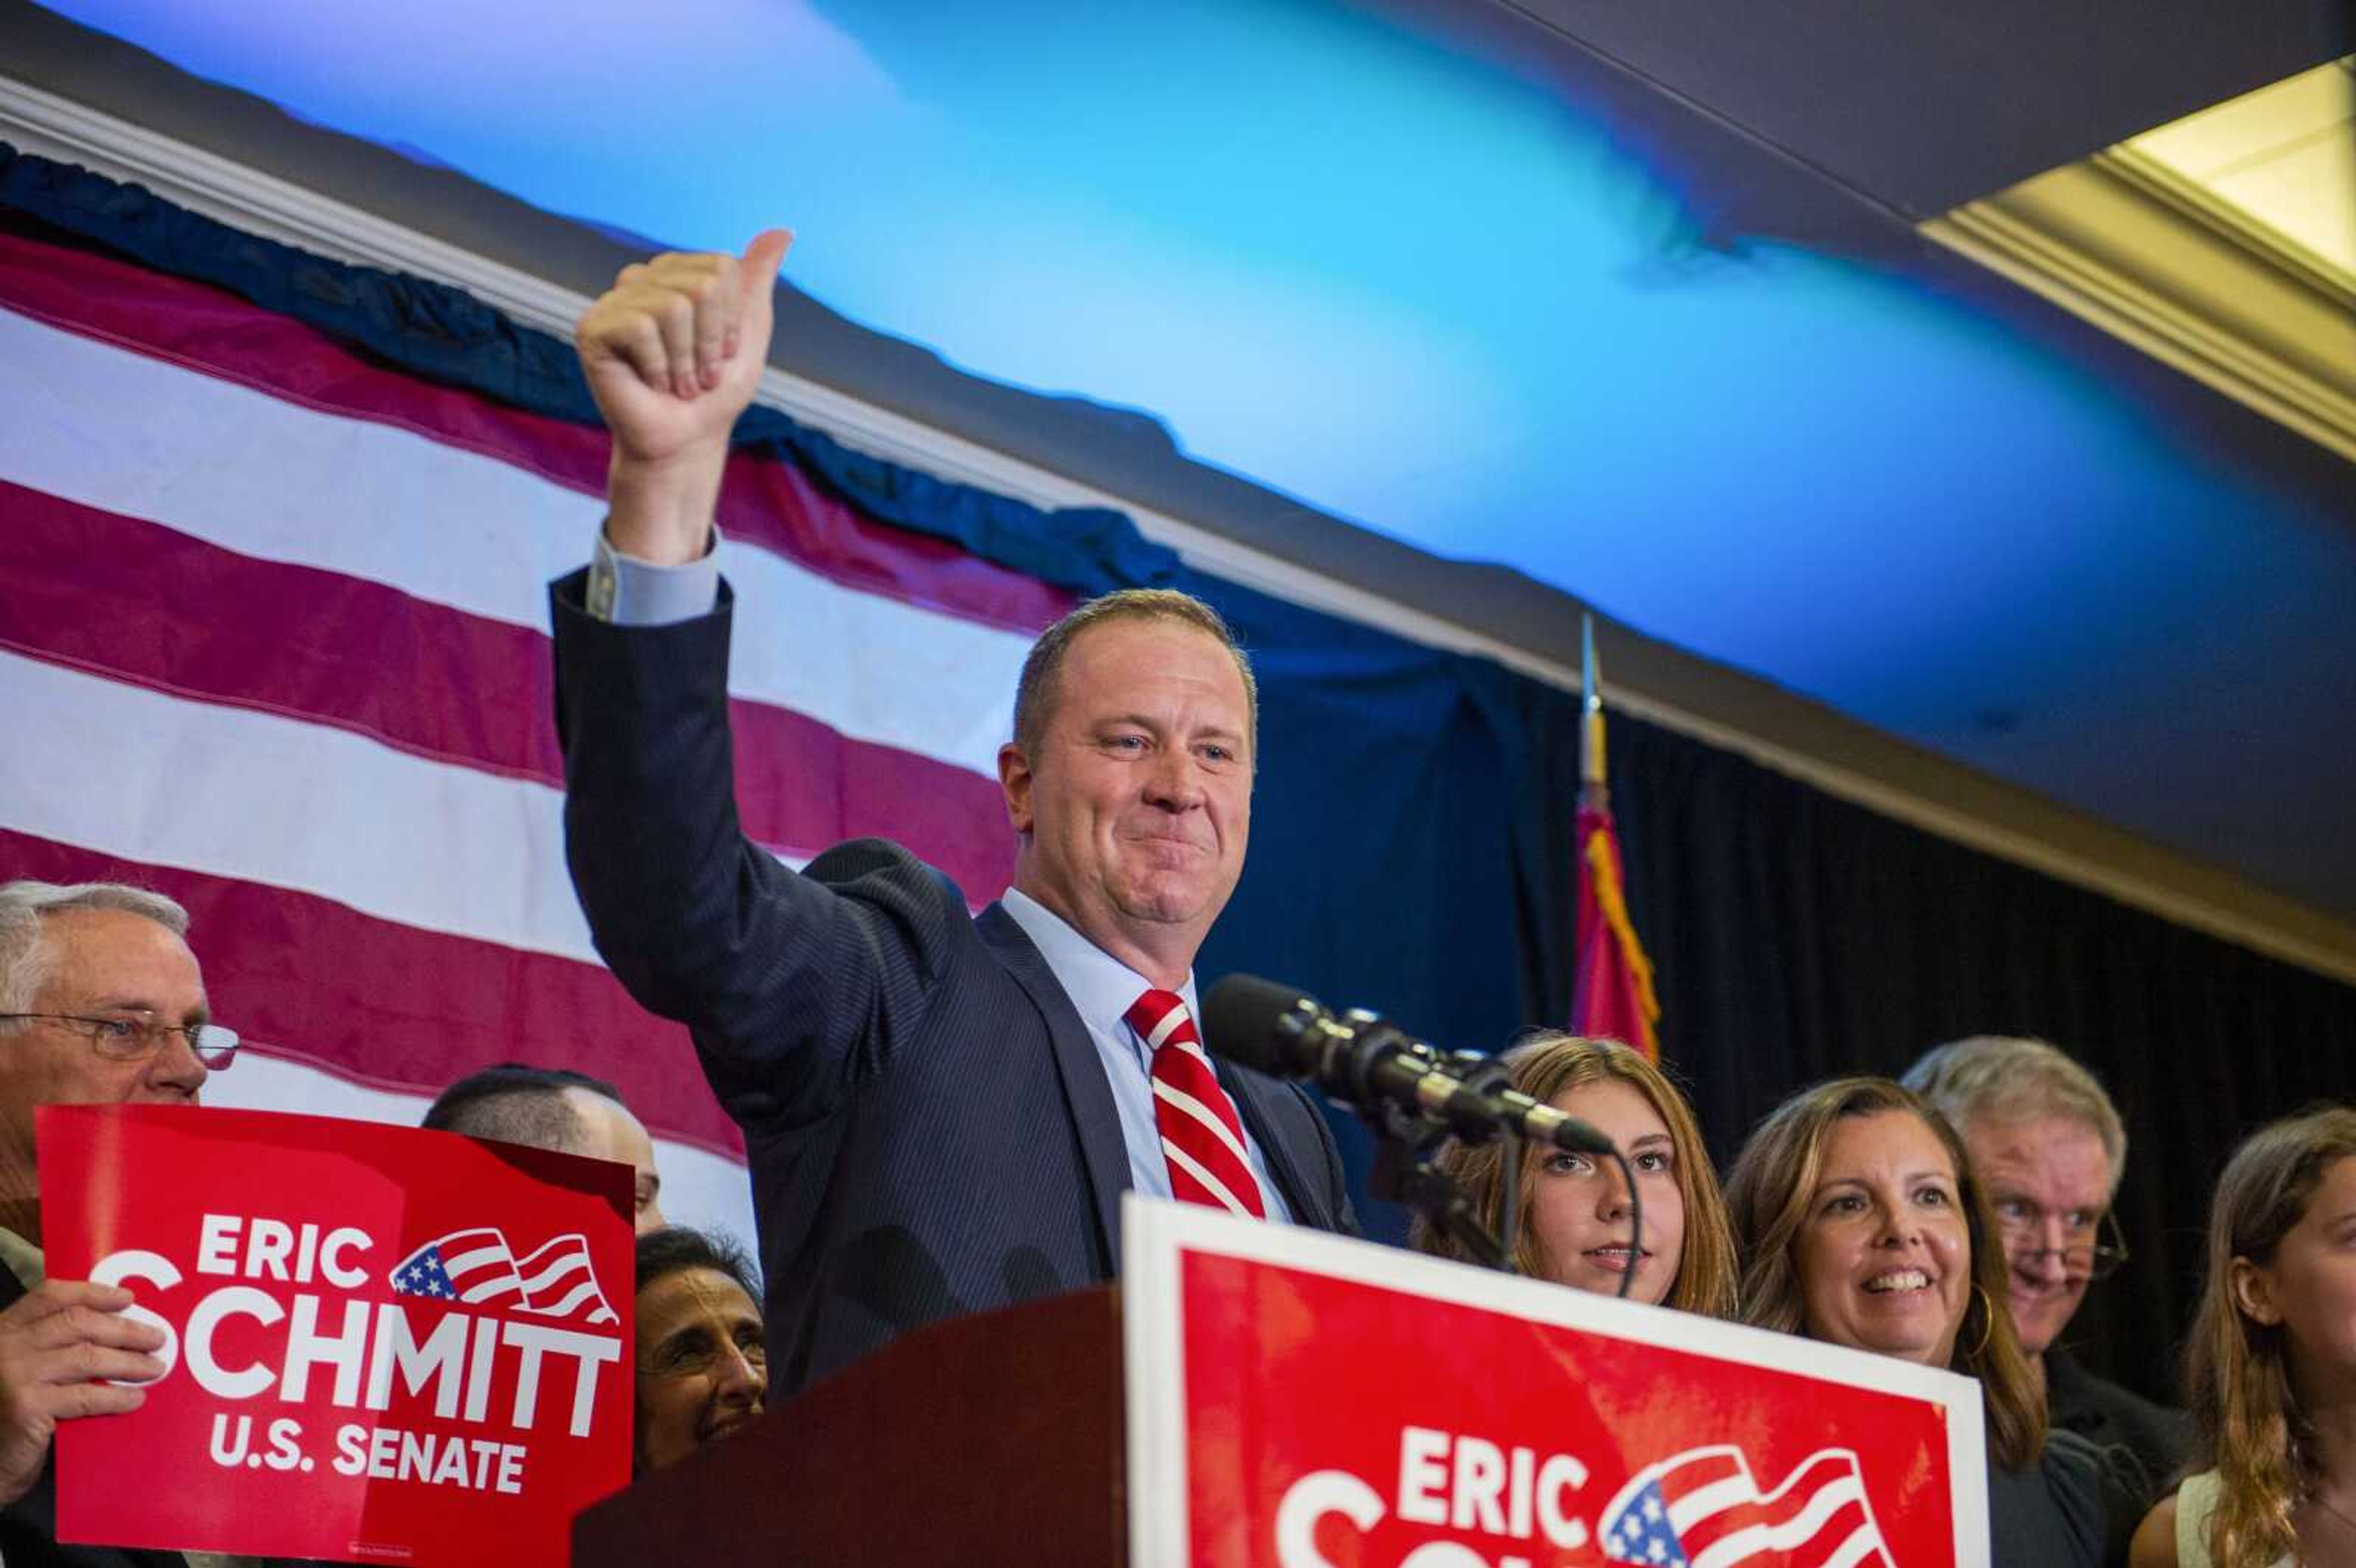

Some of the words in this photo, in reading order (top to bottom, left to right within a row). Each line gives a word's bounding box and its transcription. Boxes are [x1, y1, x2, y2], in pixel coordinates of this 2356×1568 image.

[196, 1213, 373, 1288] ERIC
[88, 1249, 621, 1438] SCHMITT
[209, 1413, 315, 1473] U.S.
[331, 1423, 526, 1494] SENATE
[1397, 1426, 1588, 1550] ERIC
